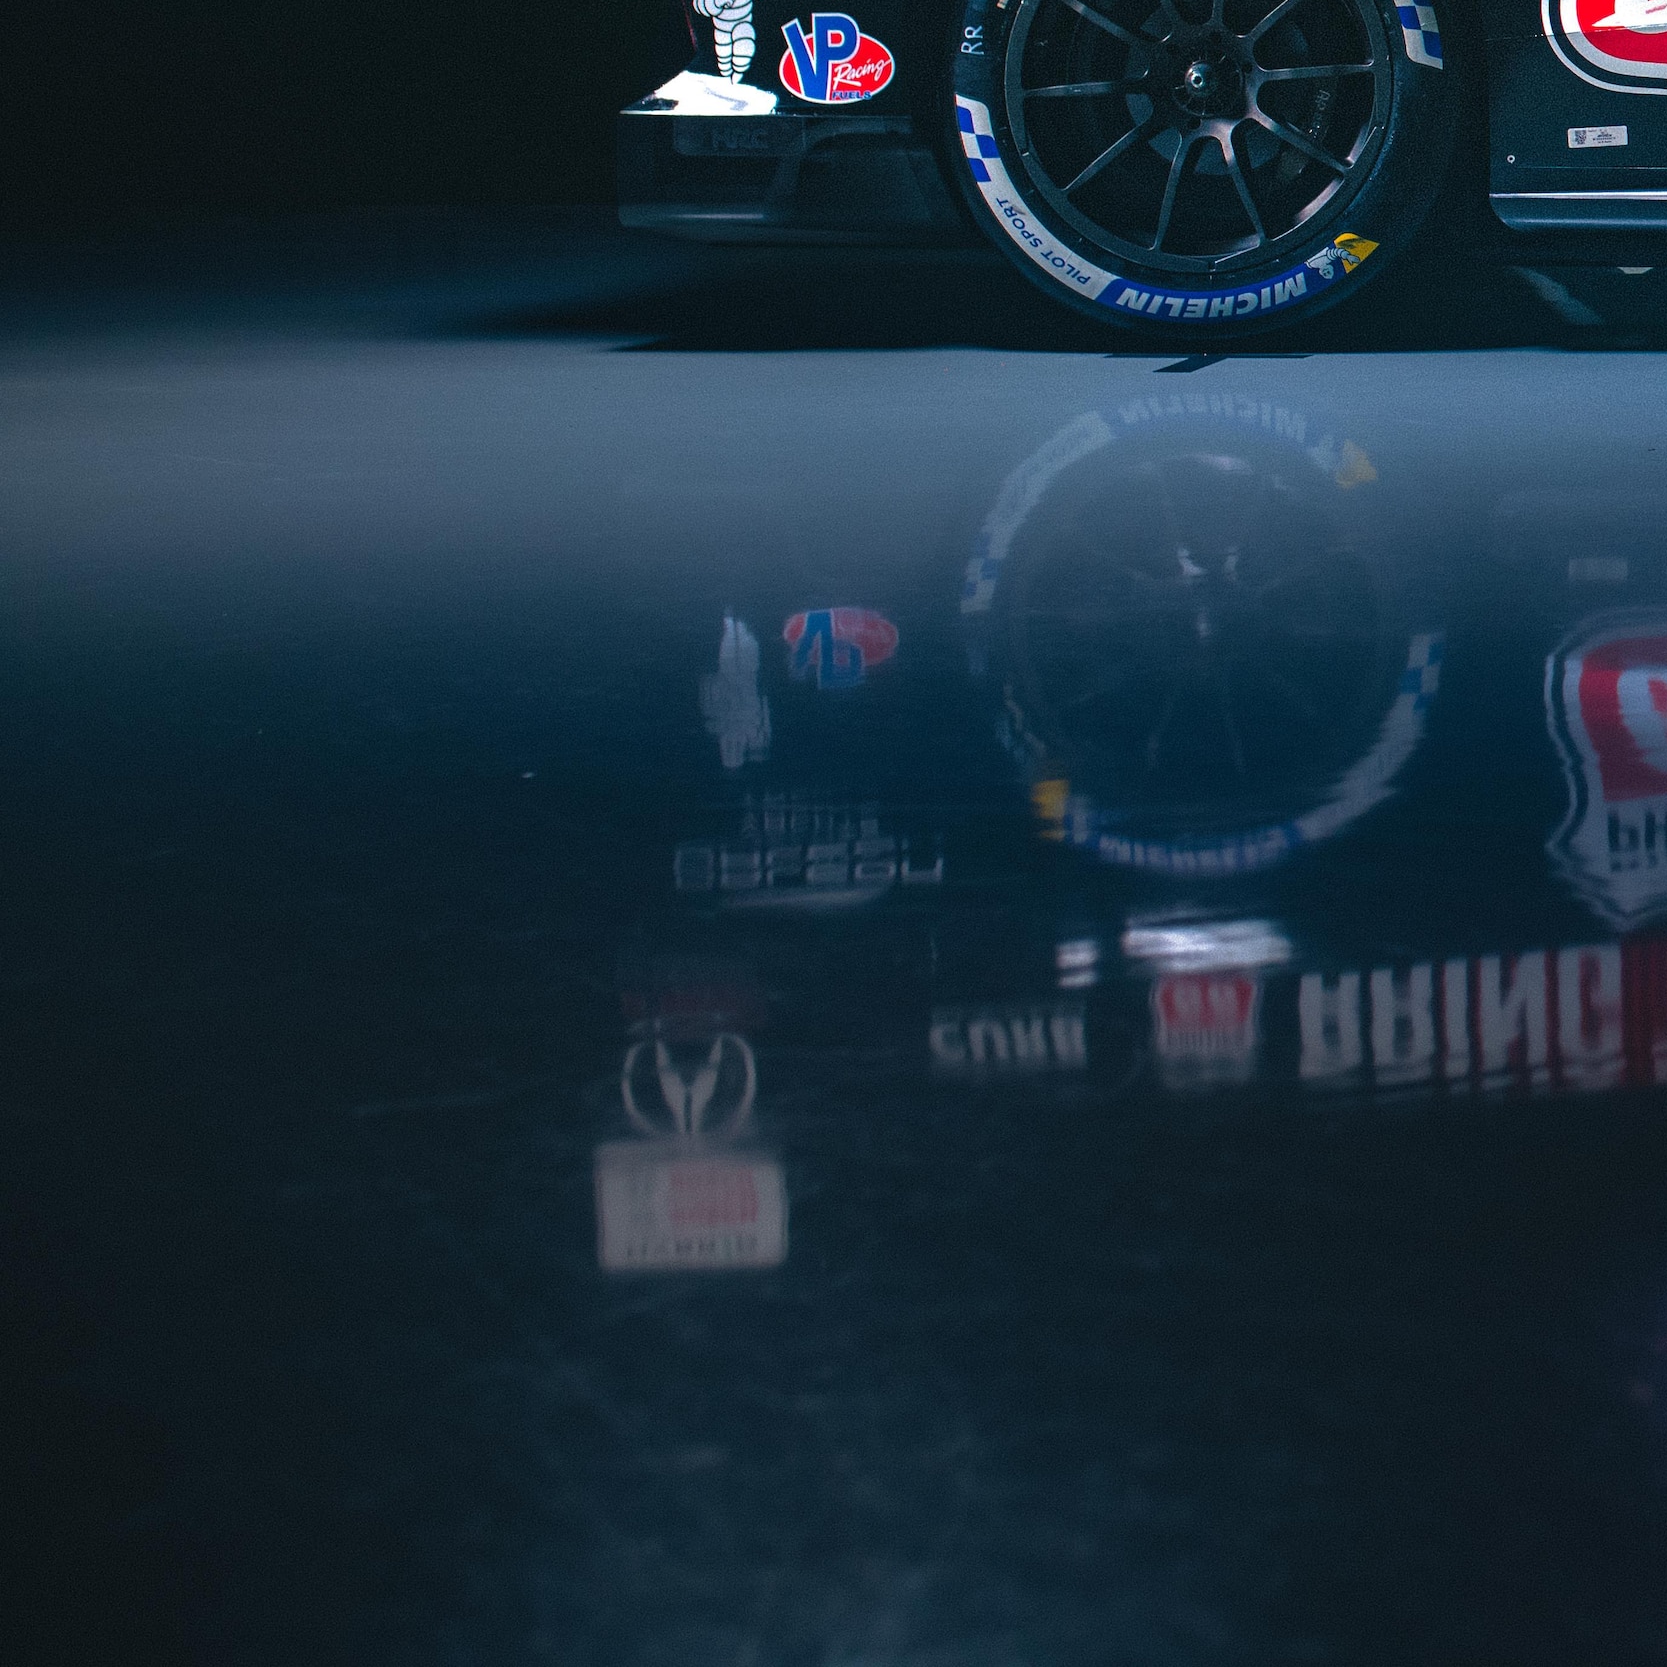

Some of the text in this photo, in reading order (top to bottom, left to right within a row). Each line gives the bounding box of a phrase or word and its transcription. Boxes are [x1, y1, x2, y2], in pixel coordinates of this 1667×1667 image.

[961, 24, 984, 55] RR
[780, 12, 860, 103] VP
[832, 58, 892, 88] Racing
[832, 90, 873, 101] FUELS
[996, 196, 1309, 318] MICHELIN PILOT SPORT
